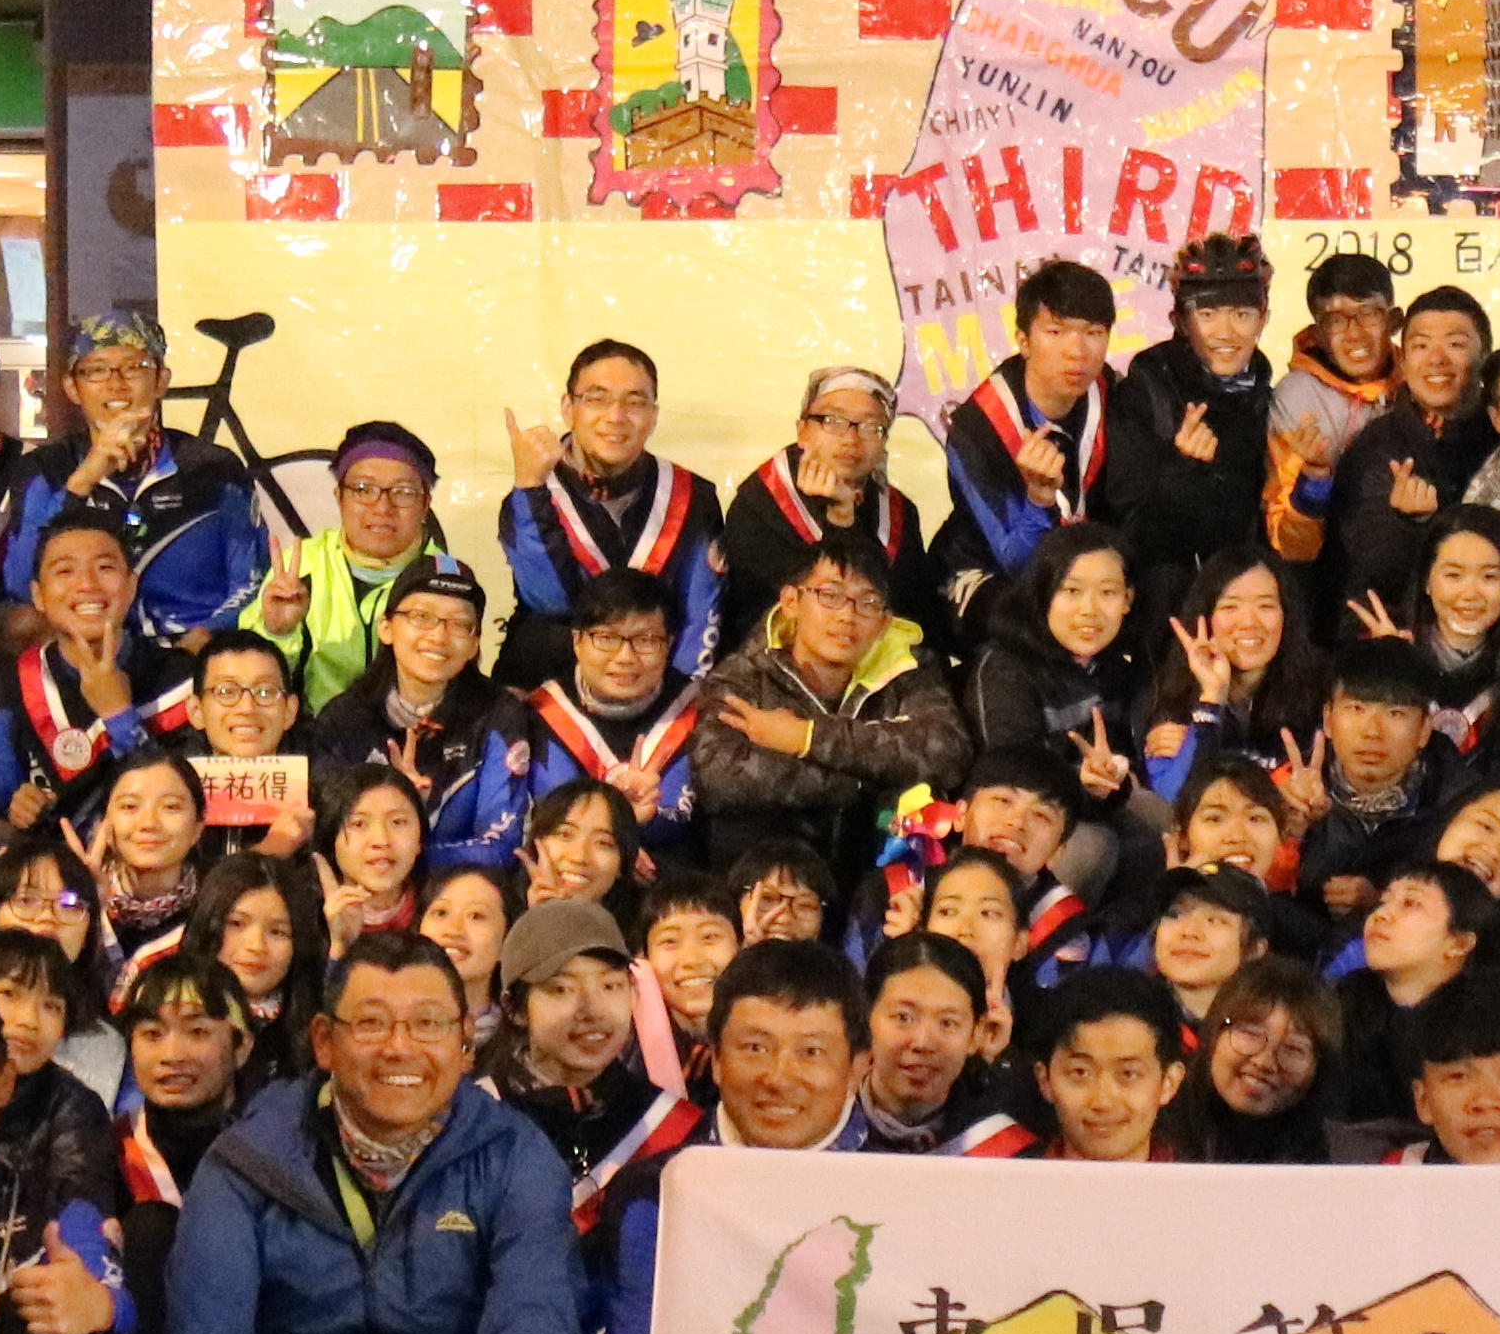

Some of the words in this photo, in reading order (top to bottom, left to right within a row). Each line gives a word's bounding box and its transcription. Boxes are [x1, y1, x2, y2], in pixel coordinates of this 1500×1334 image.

[961, 6, 1123, 99] CHANGHUA
[1073, 18, 1176, 87] NANTOU
[929, 102, 1017, 136] CHIAYI
[961, 56, 1073, 124] YUNLIN
[898, 145, 1255, 255] THIRD
[1113, 244, 1171, 291] TAIT
